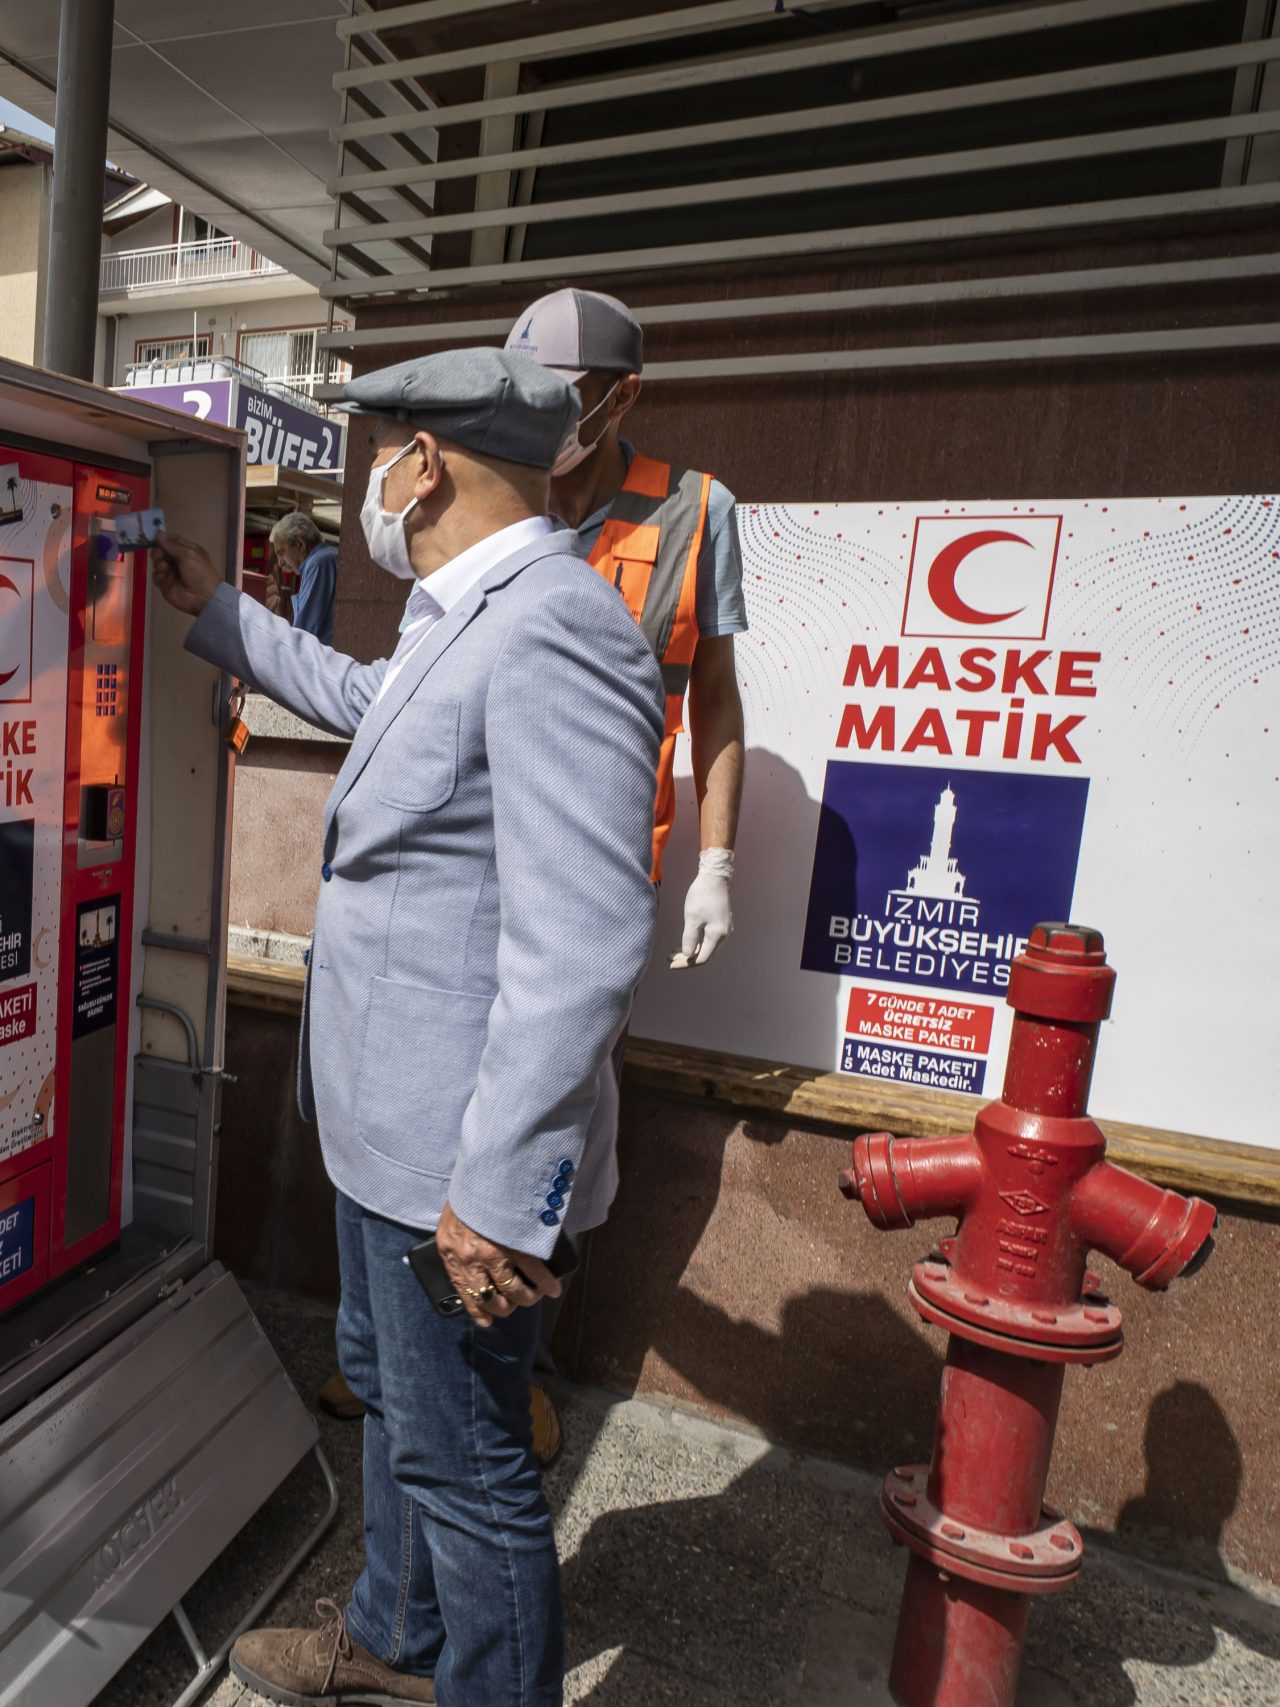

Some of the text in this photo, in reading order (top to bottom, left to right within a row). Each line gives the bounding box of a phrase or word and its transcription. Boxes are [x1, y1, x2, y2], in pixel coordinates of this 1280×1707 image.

[248, 396, 272, 420] BİZİM
[318, 427, 333, 469] 2
[842, 644, 1101, 697] MASKE
[835, 698, 1087, 764] MATİK
[885, 894, 979, 927] İZMİR
[835, 944, 1011, 986] BELEDİYES
[867, 993, 975, 1020] 7 GÜNDE 1 ADET
[884, 1008, 952, 1031] ÜCRETSİZ
[859, 1020, 975, 1050] MASKE PAKETİ
[844, 1057, 972, 1091] 5 Adet Maskedir.
[845, 1044, 976, 1077] 1 MASKE PAKETİ
